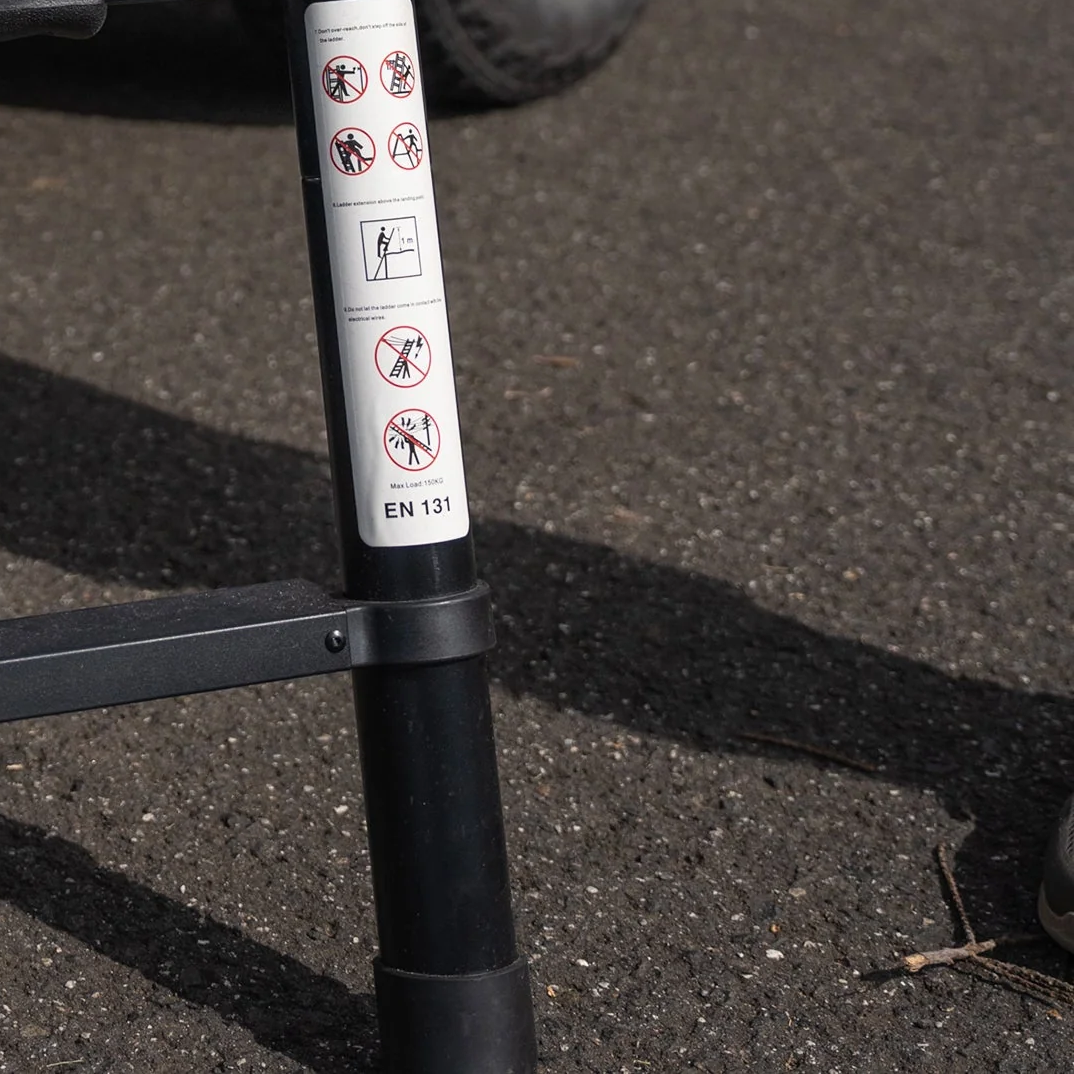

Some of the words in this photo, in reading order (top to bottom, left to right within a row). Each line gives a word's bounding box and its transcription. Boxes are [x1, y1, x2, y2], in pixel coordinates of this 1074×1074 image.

[390, 482, 404, 490] Max
[384, 500, 414, 519] EN
[421, 496, 451, 516] 131
